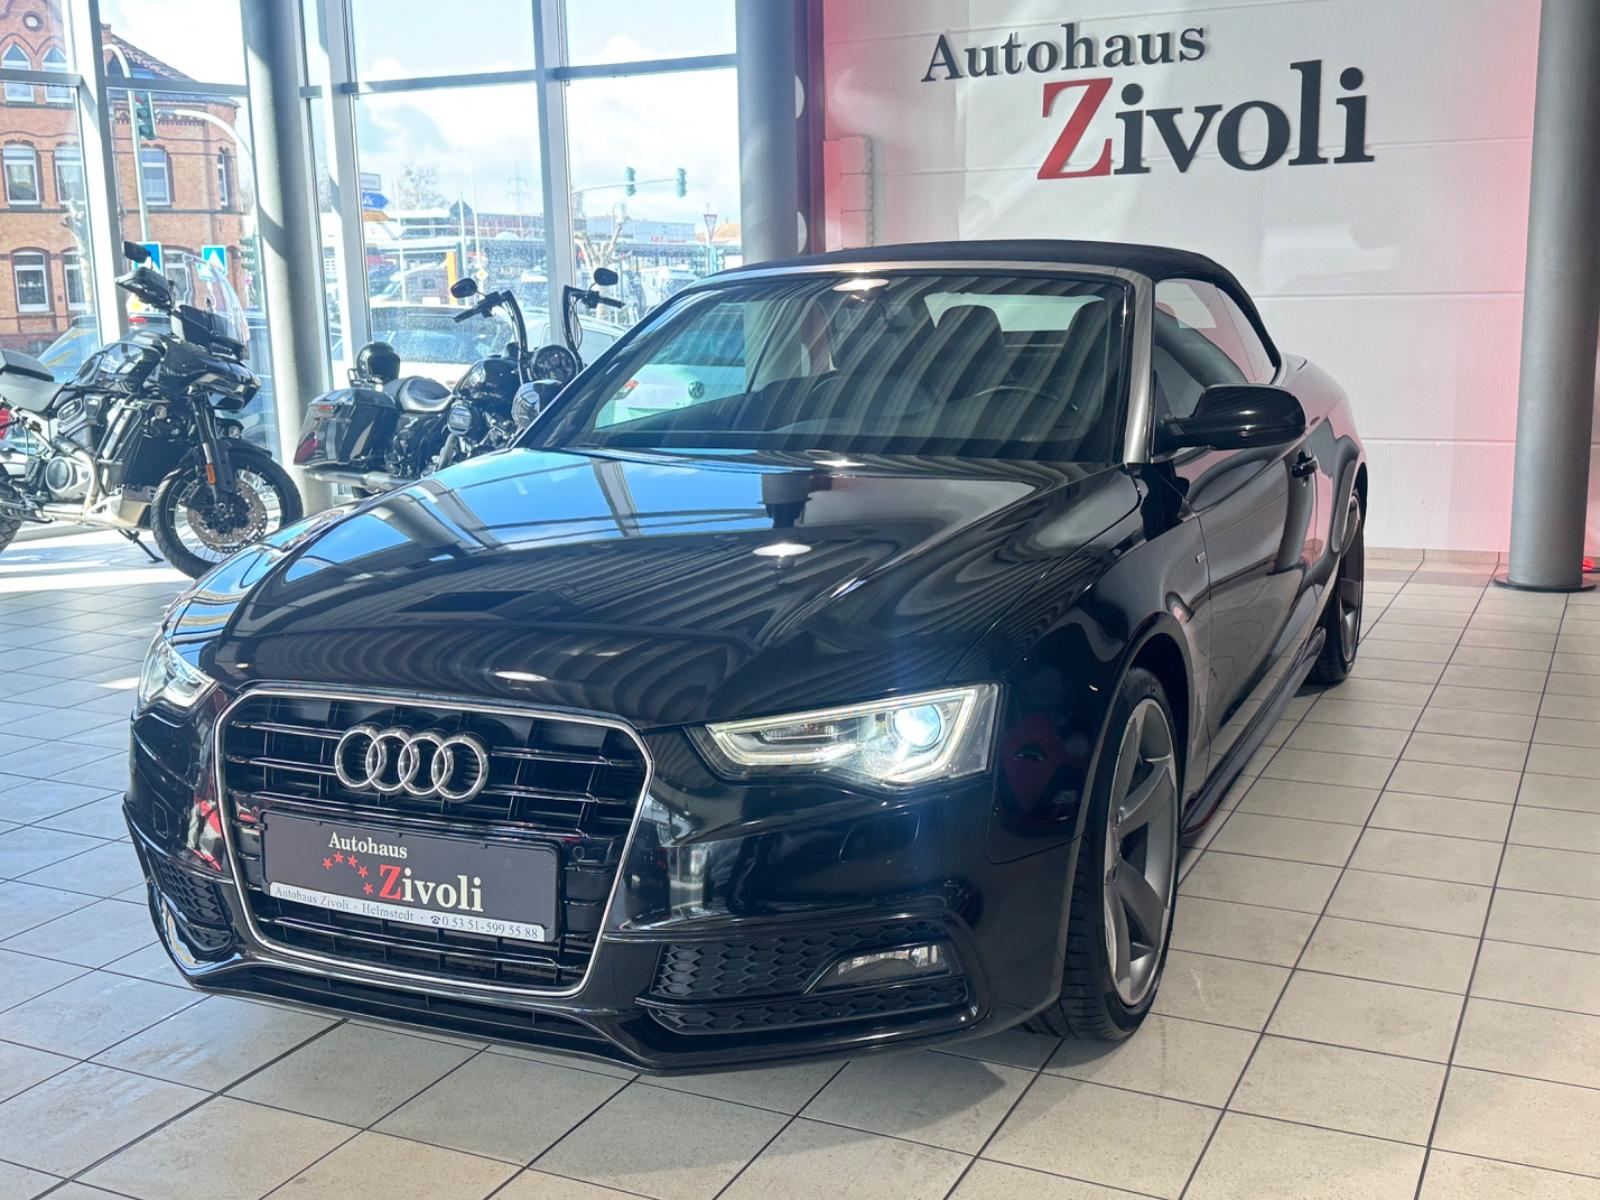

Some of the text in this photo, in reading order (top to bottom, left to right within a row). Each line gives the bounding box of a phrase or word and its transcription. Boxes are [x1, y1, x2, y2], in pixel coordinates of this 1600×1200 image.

[921, 22, 1207, 82] Autohaus
[1037, 59, 1375, 181] Zivoli
[328, 832, 408, 859] Autohaus
[274, 886, 318, 905] Autohaus
[320, 893, 350, 910] Zivoli
[362, 903, 414, 921] Helmstedt
[452, 917, 465, 929] 53
[468, 920, 505, 935] 51-599
[509, 925, 521, 937] 55
[525, 927, 538, 940] 88
[379, 864, 484, 912] Zivoli
